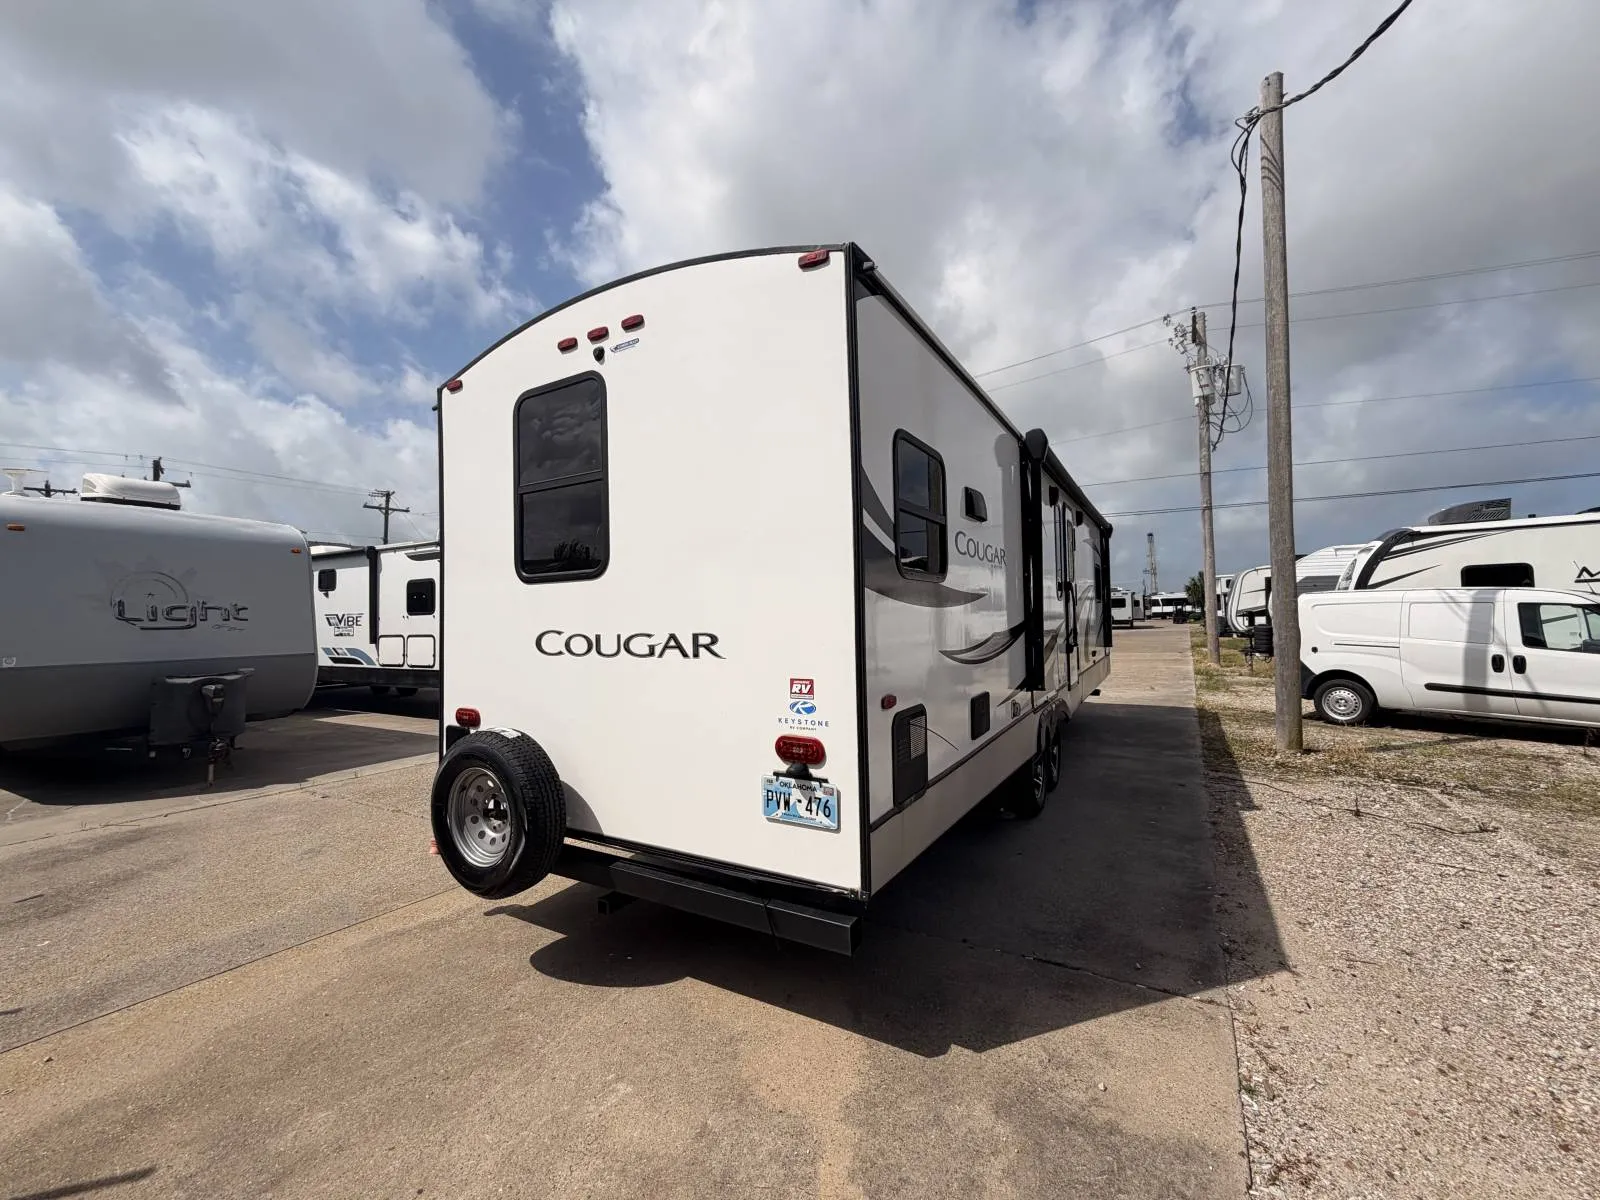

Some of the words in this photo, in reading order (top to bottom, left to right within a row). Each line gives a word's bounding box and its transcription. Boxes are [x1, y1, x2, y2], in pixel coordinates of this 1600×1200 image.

[955, 531, 1007, 567] COUGAR
[112, 599, 249, 630] Light
[326, 613, 363, 627] VIBE
[535, 629, 727, 660] COUGAR
[791, 683, 812, 694] RV
[778, 717, 830, 728] KEYSTONE
[779, 780, 818, 793] OKLAHOMA
[766, 789, 791, 812] PVW
[805, 795, 831, 818] 476
